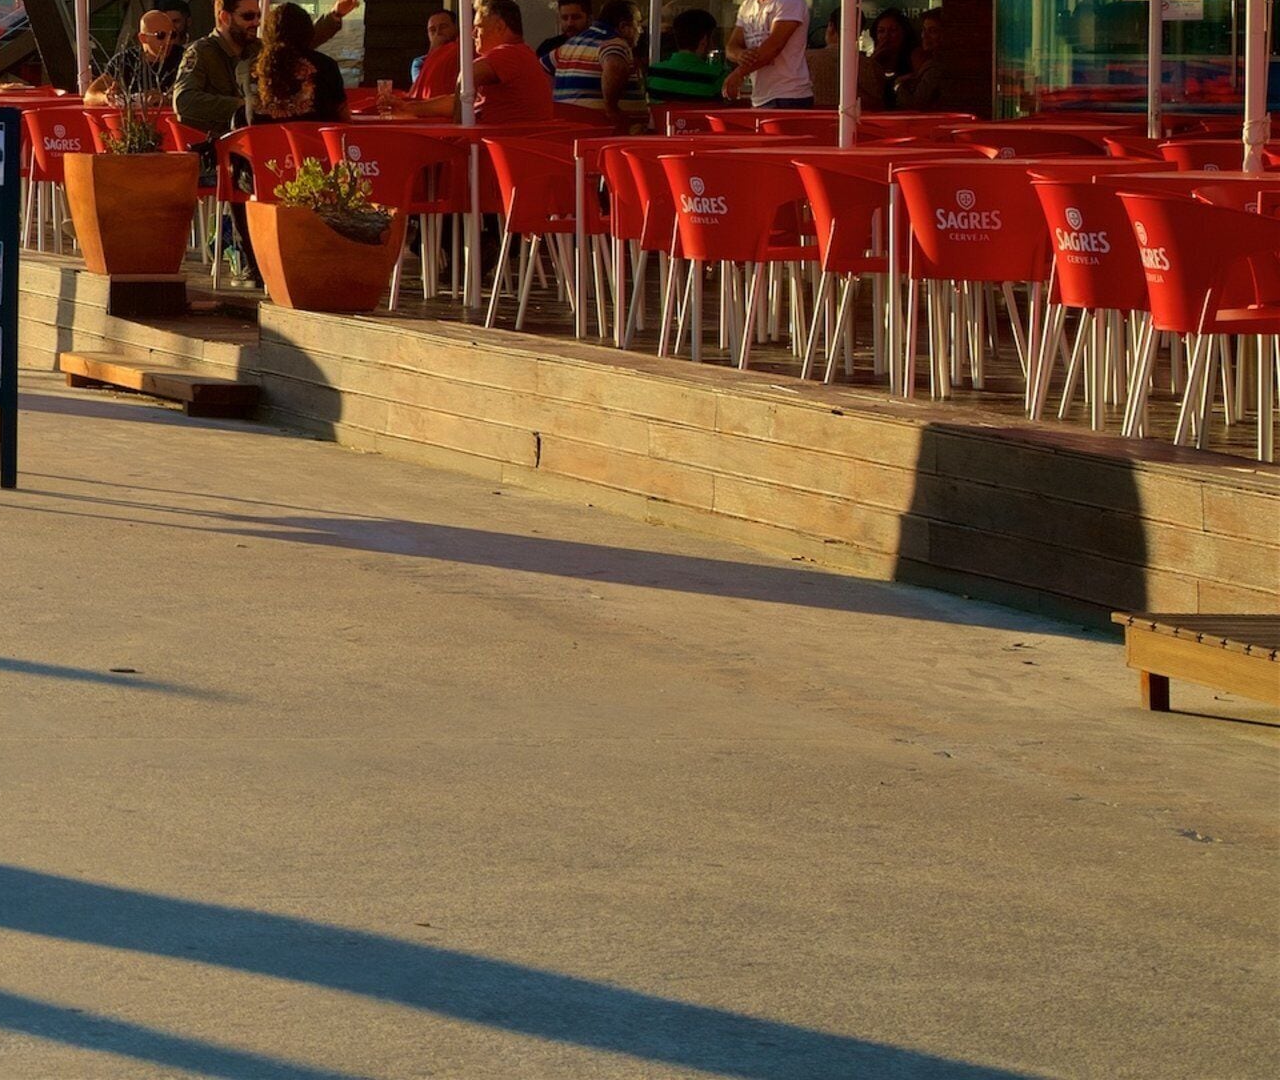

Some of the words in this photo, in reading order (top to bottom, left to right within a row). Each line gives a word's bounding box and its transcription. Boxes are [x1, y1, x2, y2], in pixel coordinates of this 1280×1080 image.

[44, 135, 82, 151] SAGRES
[680, 192, 729, 216] SAGRES
[936, 208, 1003, 230] SAGRES
[948, 232, 990, 242] CERVEJA
[1055, 227, 1111, 254] SAGRES
[1066, 255, 1101, 266] CERVEJA
